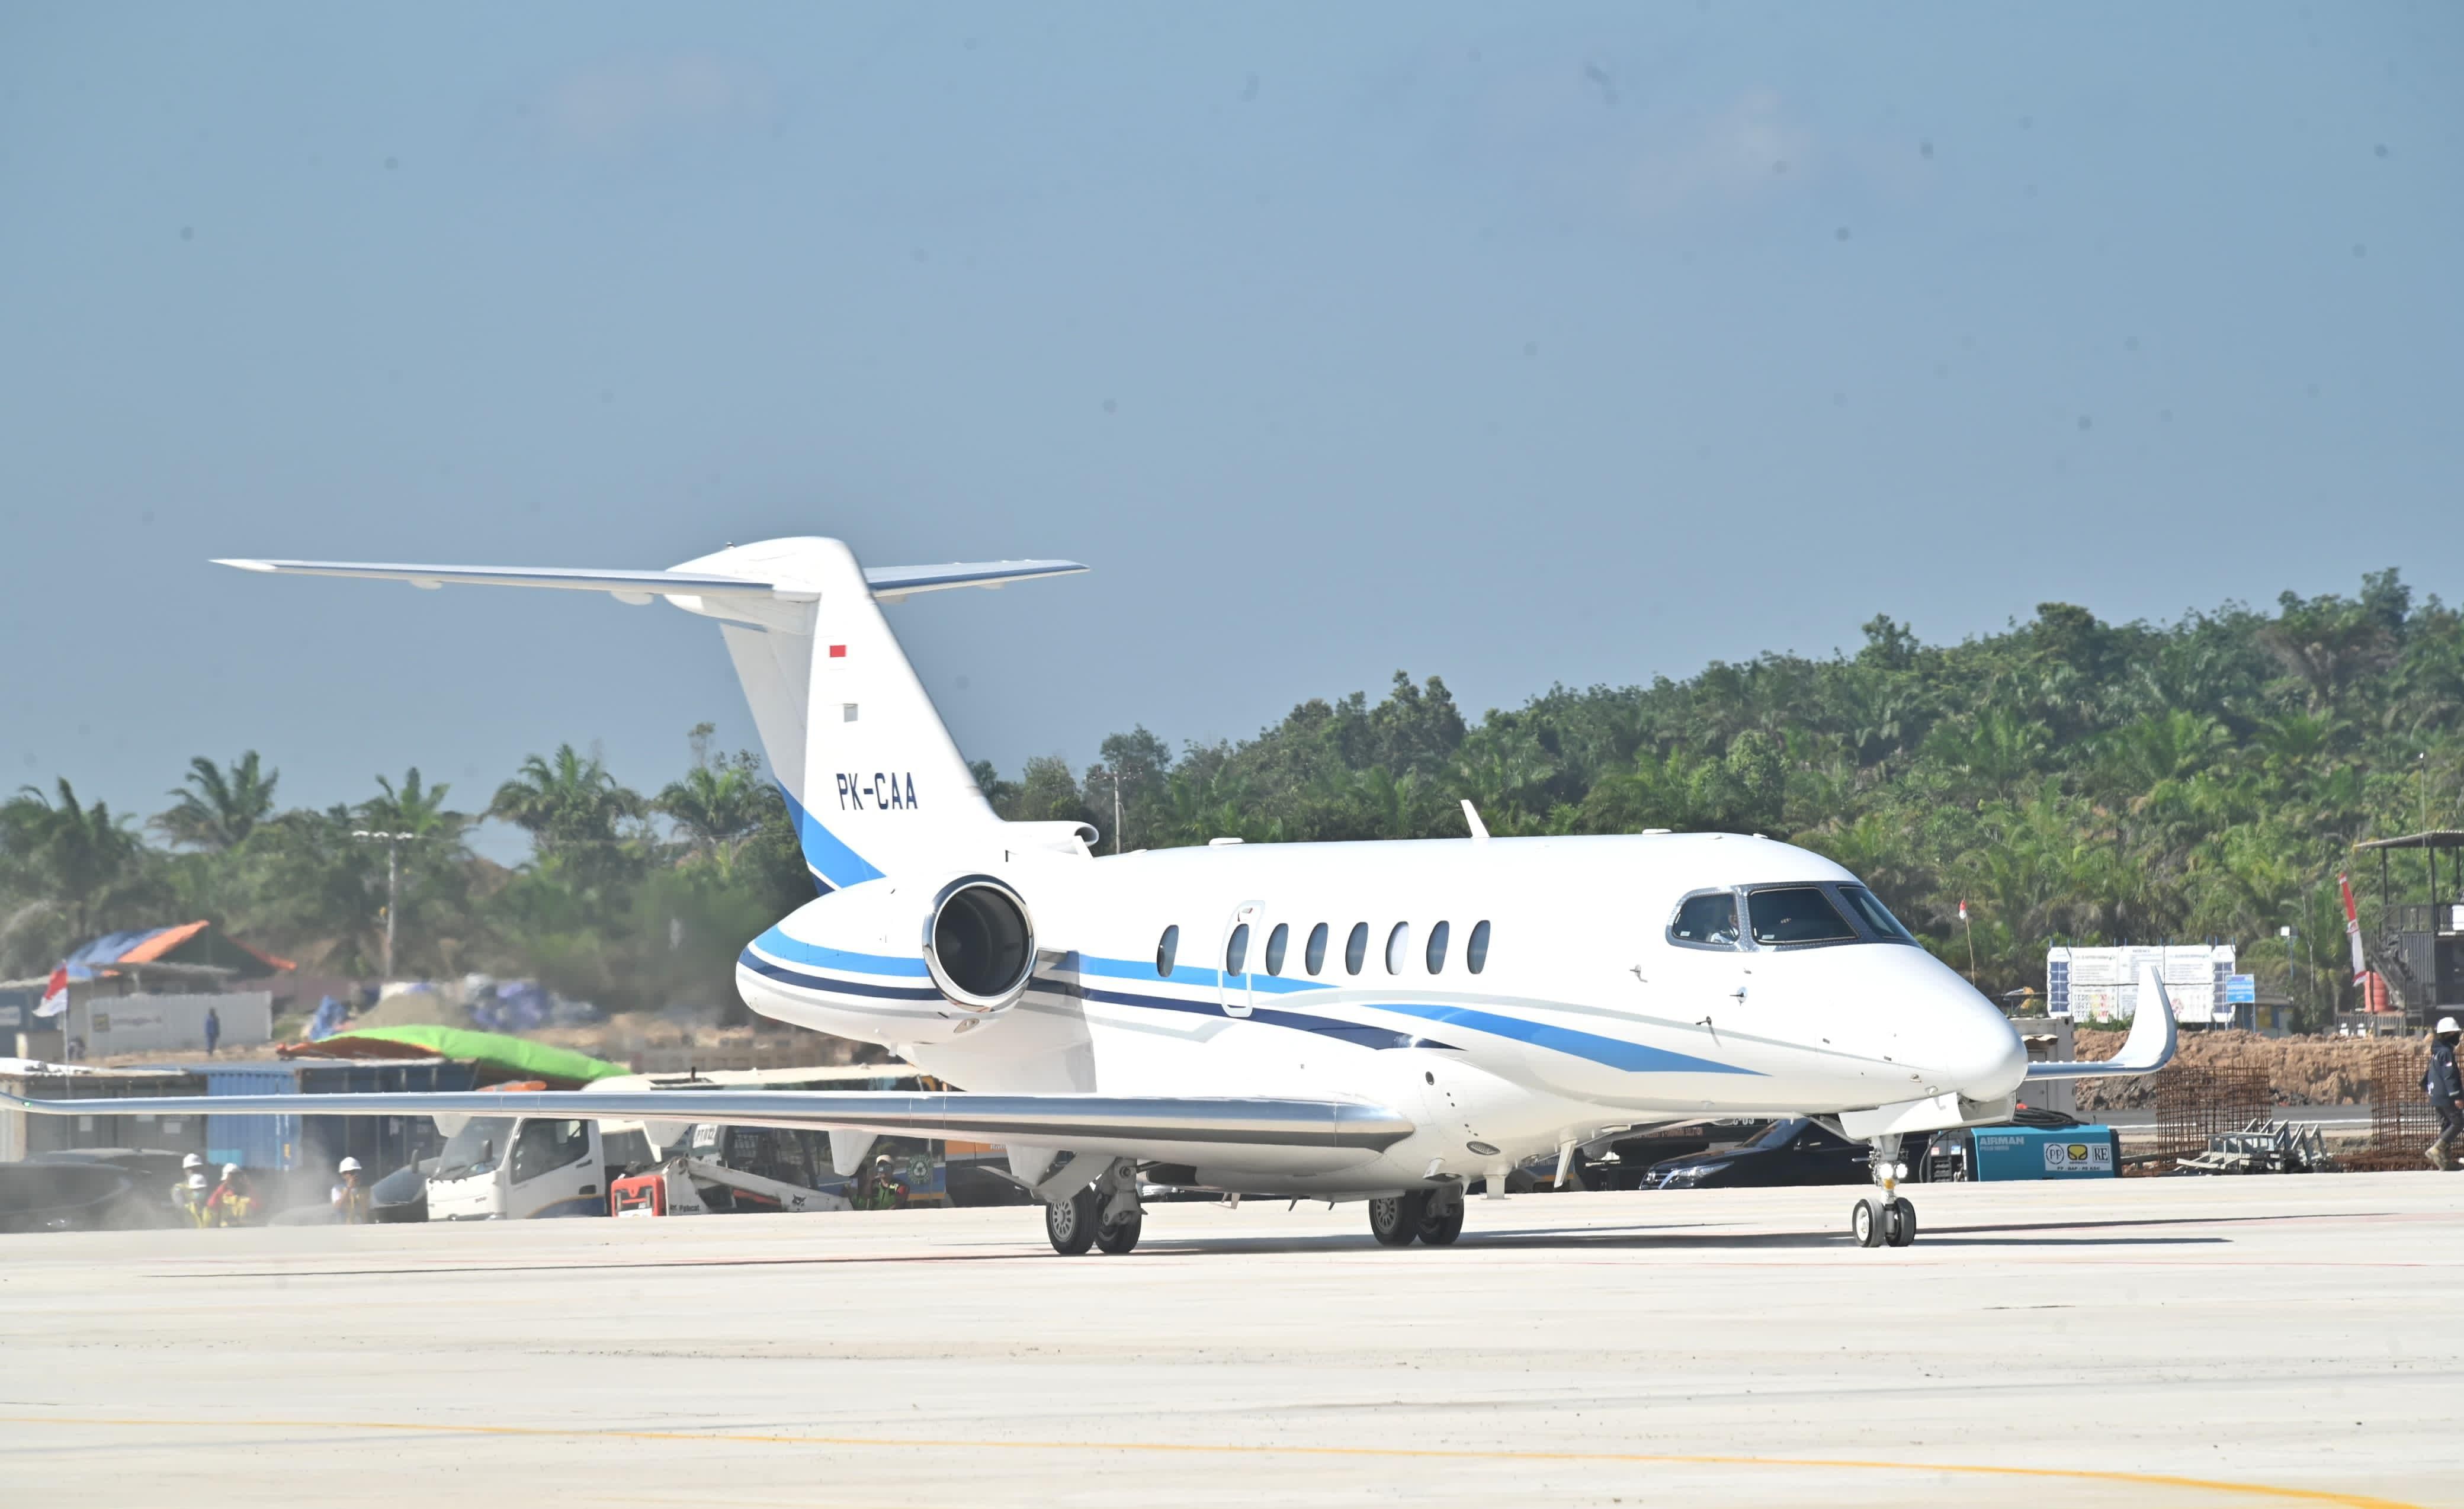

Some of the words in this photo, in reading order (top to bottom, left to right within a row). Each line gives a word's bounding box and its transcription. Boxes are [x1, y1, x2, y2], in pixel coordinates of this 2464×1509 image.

[836, 772, 918, 811] PK-CAA
[1979, 1136, 2025, 1145] AIRMAN
[2049, 1149, 2062, 1160] PP
[2094, 1147, 2109, 1161] RE
